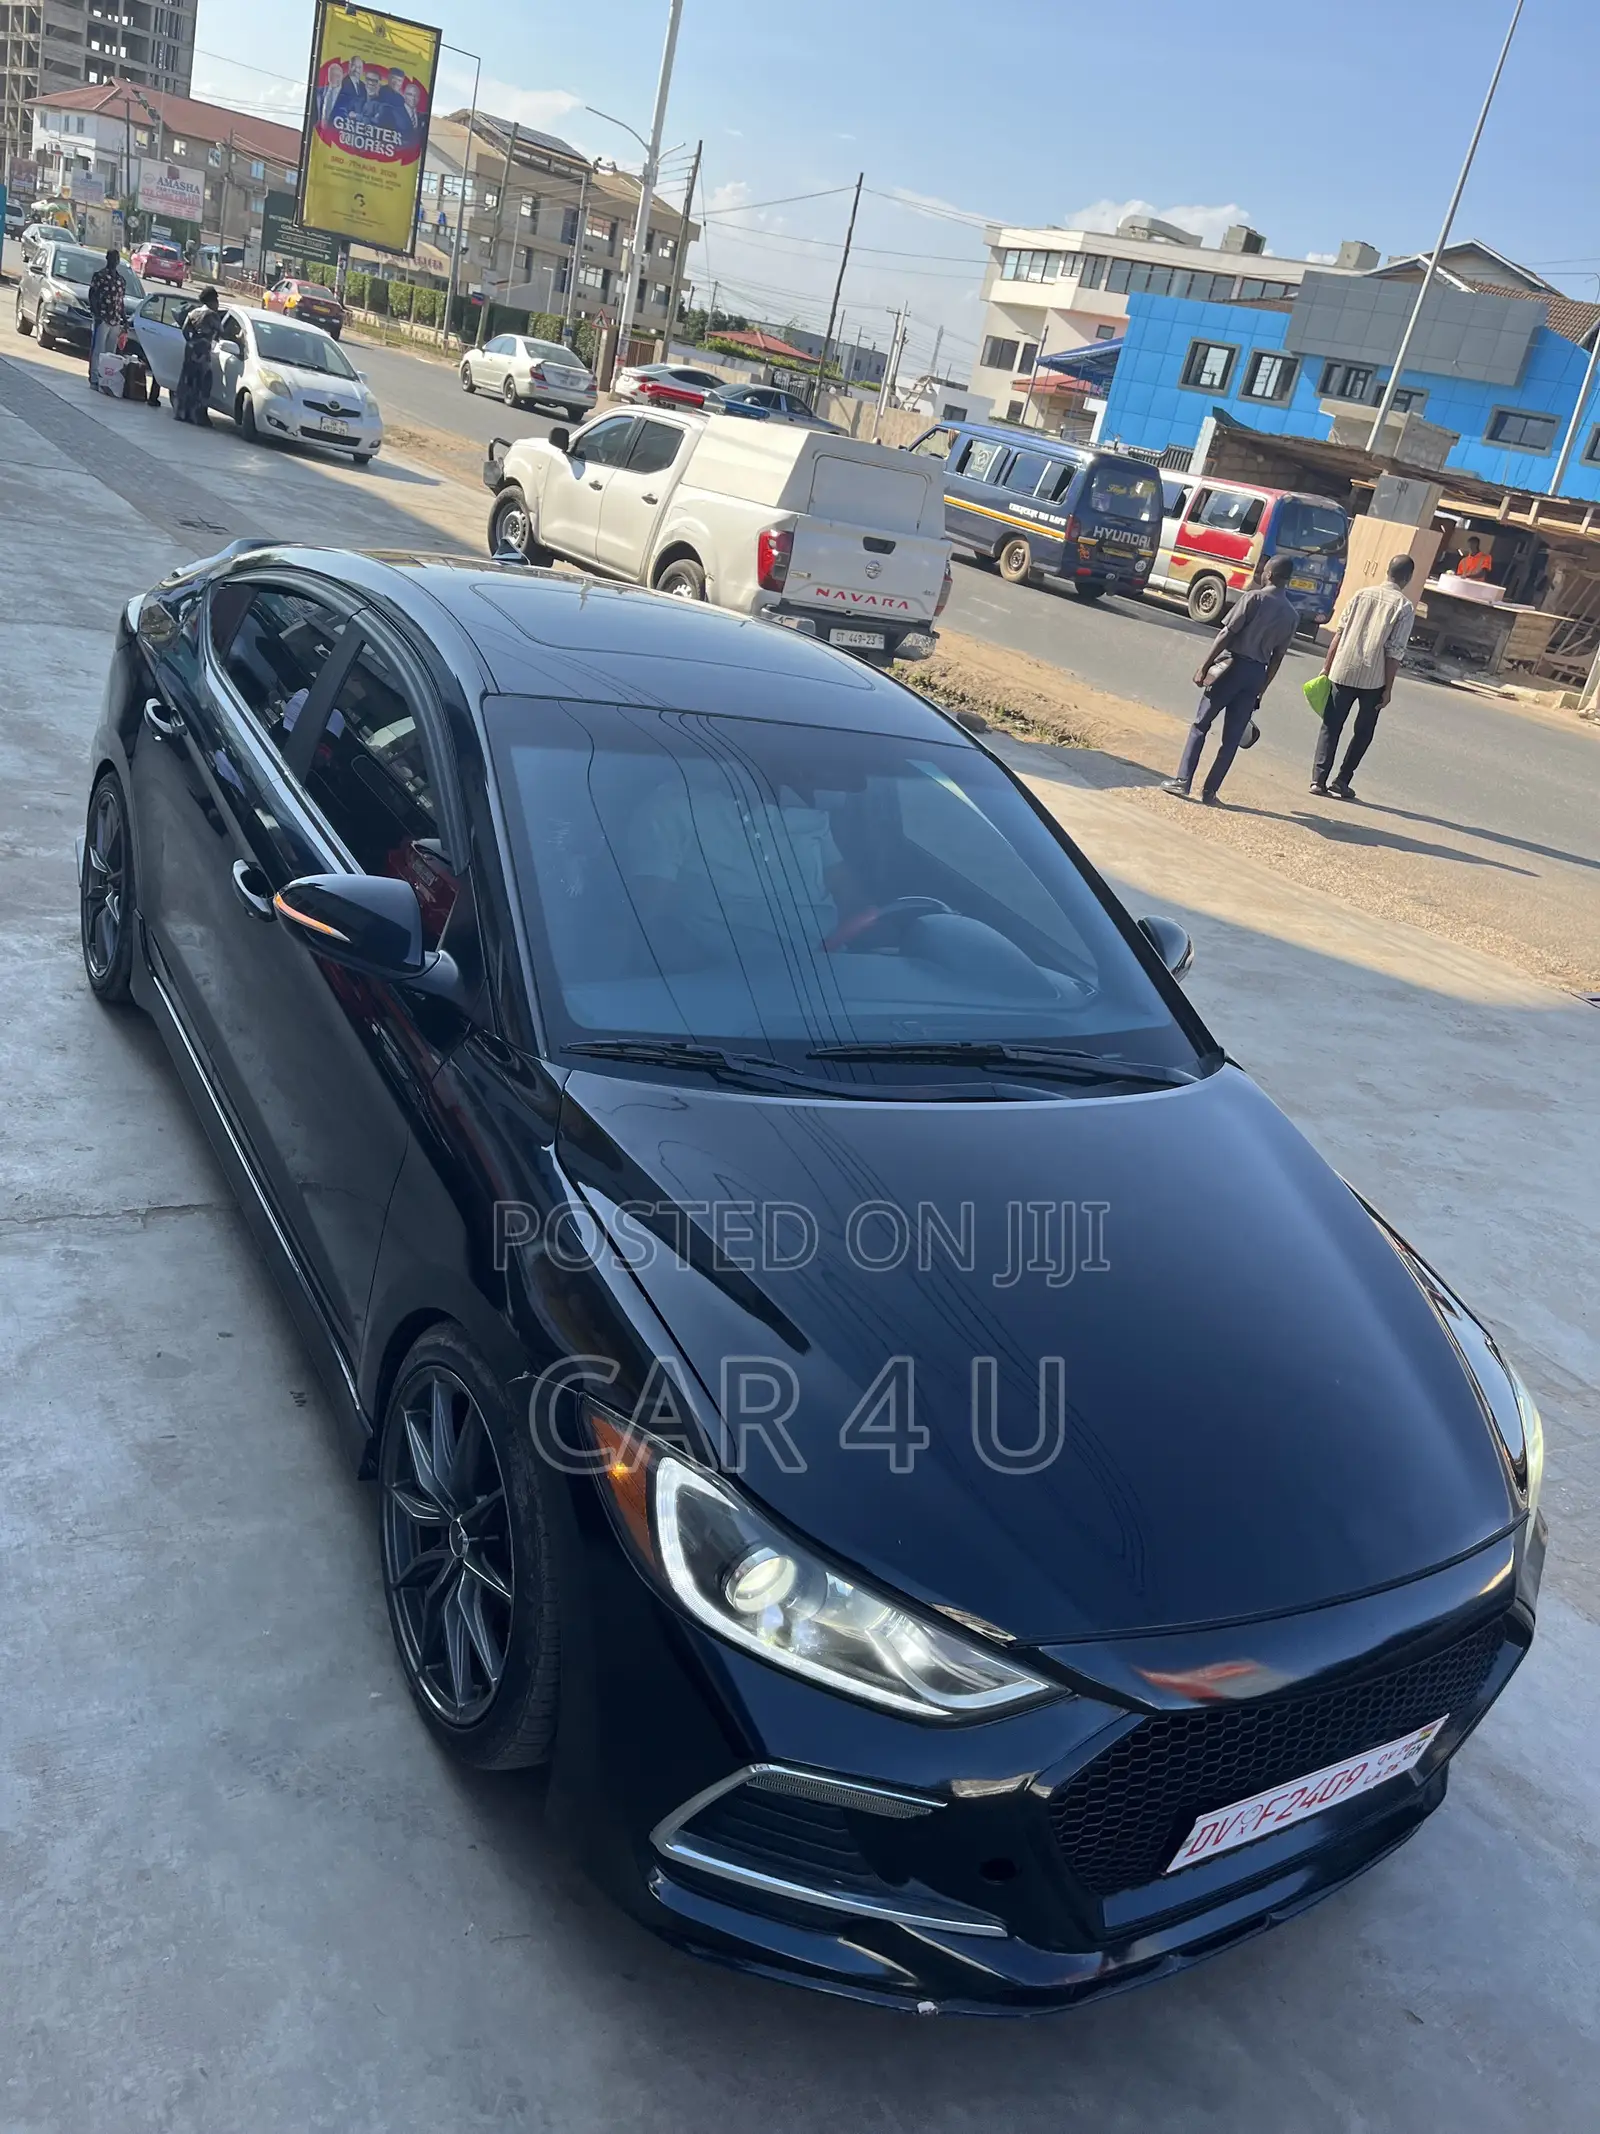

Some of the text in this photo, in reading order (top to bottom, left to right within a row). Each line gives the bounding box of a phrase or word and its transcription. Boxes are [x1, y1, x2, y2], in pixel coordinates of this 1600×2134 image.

[333, 116, 403, 146] GREATER
[339, 130, 395, 157] WORKS
[156, 177, 201, 195] AMASHA
[1093, 525, 1152, 549] HYUNDAI
[815, 587, 909, 610] NAVARA
[1184, 1762, 1369, 1857] DV F2409
